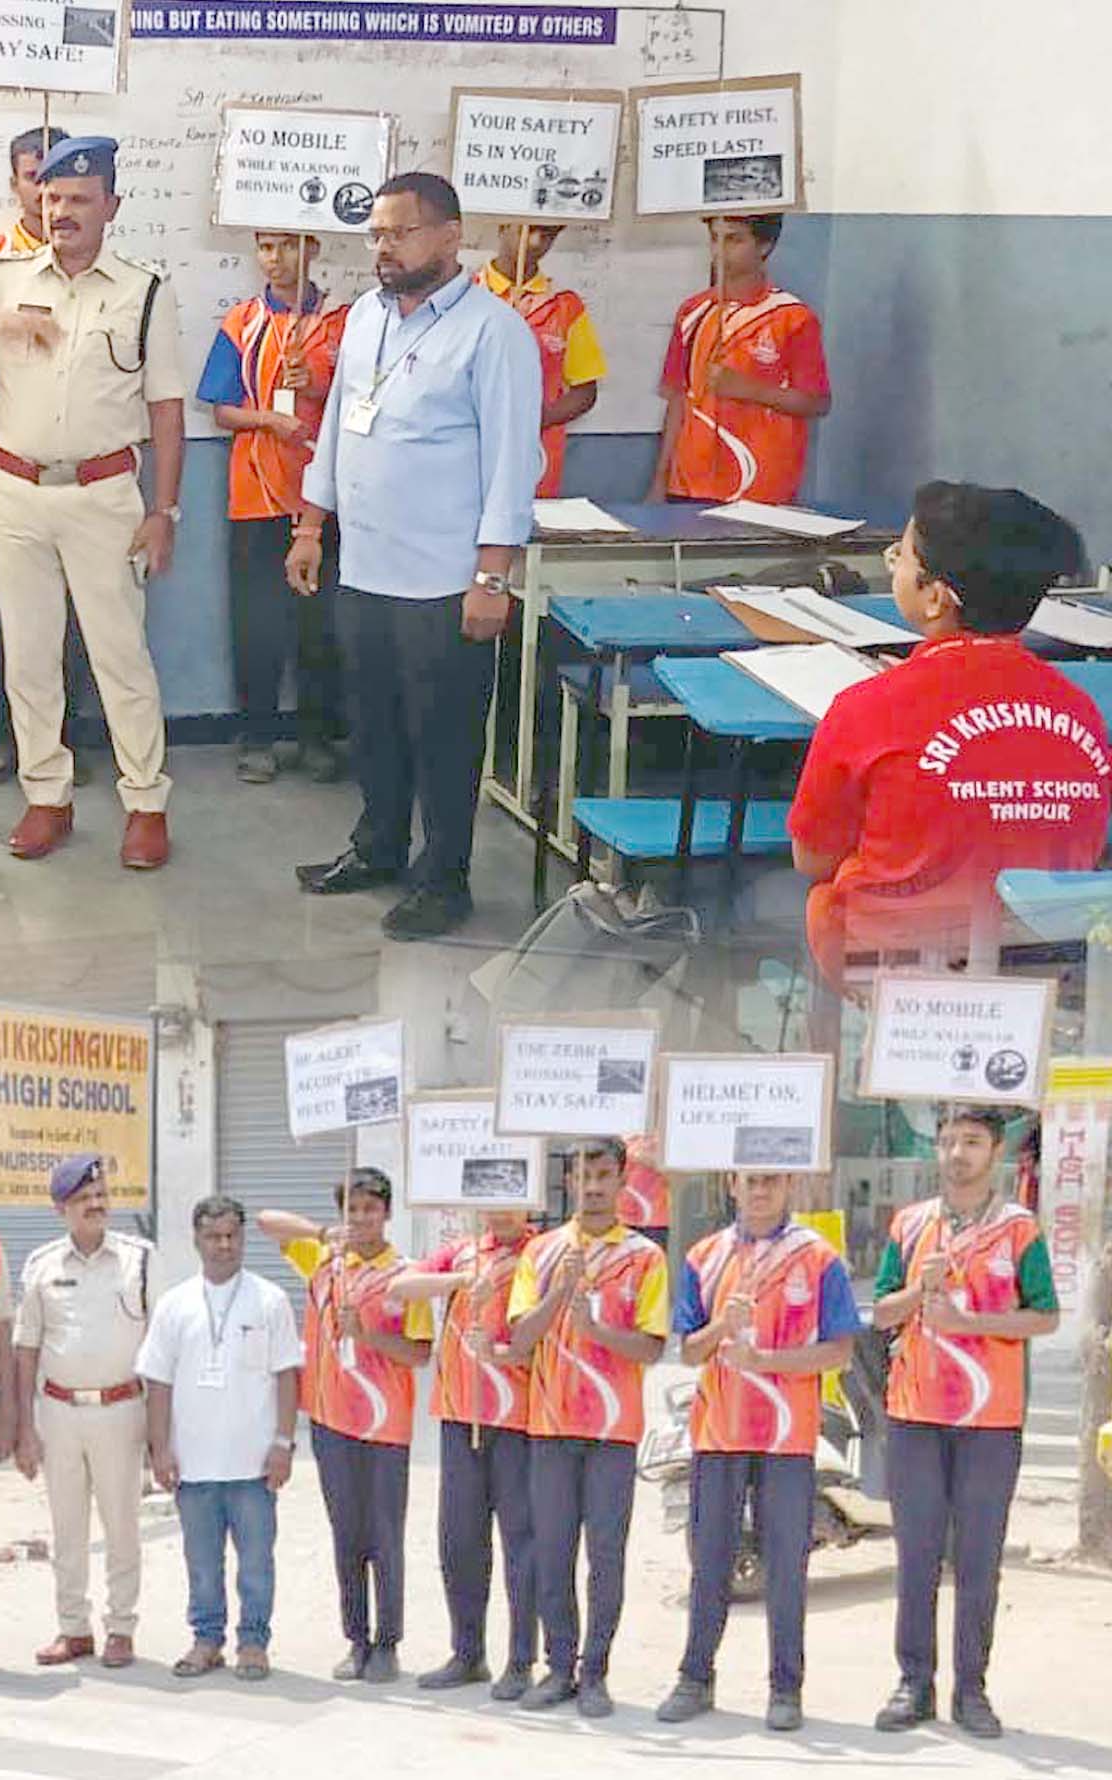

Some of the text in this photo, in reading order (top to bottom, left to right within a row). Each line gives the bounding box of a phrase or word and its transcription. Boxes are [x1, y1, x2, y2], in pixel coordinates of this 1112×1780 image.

[169, 10, 200, 30] BUT
[205, 11, 262, 30] EATING
[267, 11, 360, 31] SOMETHING
[365, 13, 419, 32] WHICH
[424, 15, 438, 33] IS
[444, 15, 514, 34] VOMITED
[518, 17, 538, 35] BY
[542, 18, 603, 36] OTHERS
[26, 45, 84, 62] SAFE!
[470, 113, 594, 135] YOUR SAFETY
[653, 110, 719, 129] SAFETY
[240, 130, 347, 150] NO MOBILE
[652, 138, 764, 159] SPEED LAST!
[467, 143, 557, 162] IS IN YOUR
[238, 159, 361, 177] WHILE WALKING OR
[236, 180, 294, 194] DRIVING!
[464, 172, 529, 189] HANDS!
[918, 702, 1112, 776] SRI KRISHNAVENI
[948, 781, 1101, 800] TALENT SCHOOL
[989, 803, 1071, 821] TANDUR
[12, 1021, 149, 1073] KRISHNAVENI
[58, 1077, 136, 1114] SCHOOL
